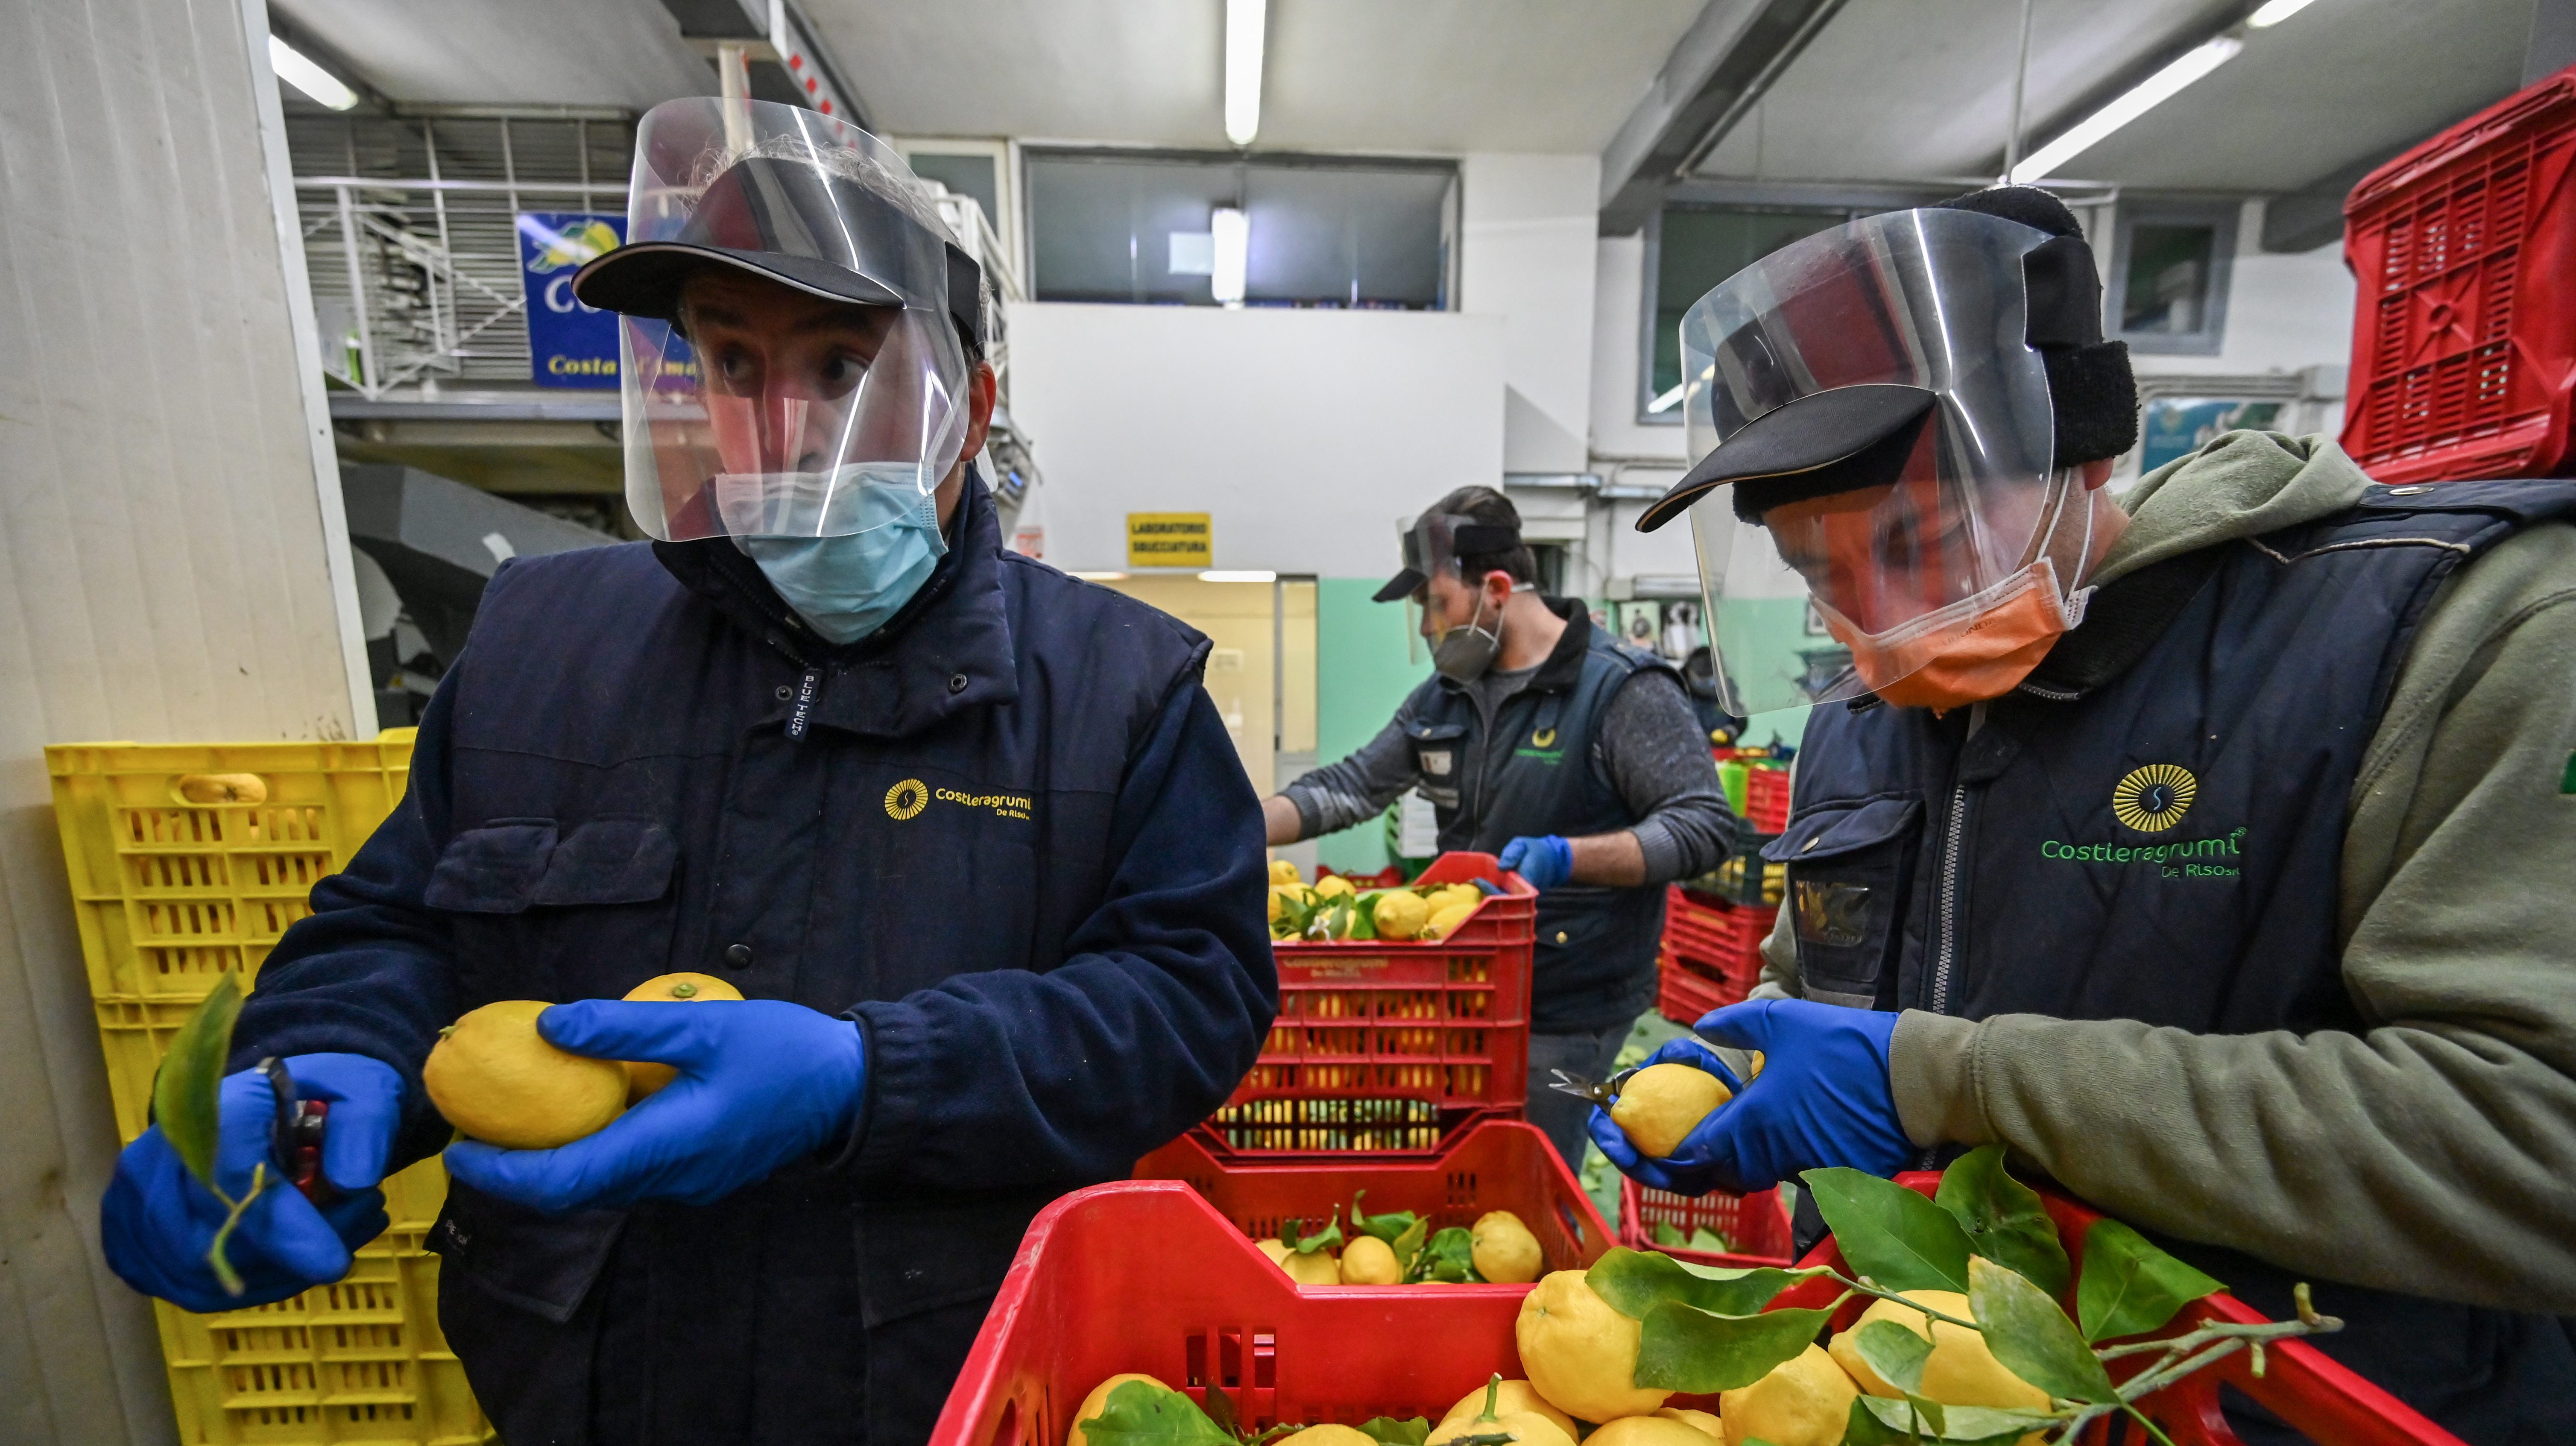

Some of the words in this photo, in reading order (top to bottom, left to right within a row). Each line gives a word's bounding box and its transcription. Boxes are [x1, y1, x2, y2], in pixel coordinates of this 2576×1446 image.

[548, 354, 617, 375] Costa
[1133, 522, 1207, 534] LABORATORIO
[1133, 541, 1207, 552] SBUCCIATURA
[800, 675, 814, 702] BLUE
[936, 788, 1031, 811] Costieragrumi
[2161, 866, 2179, 878] De
